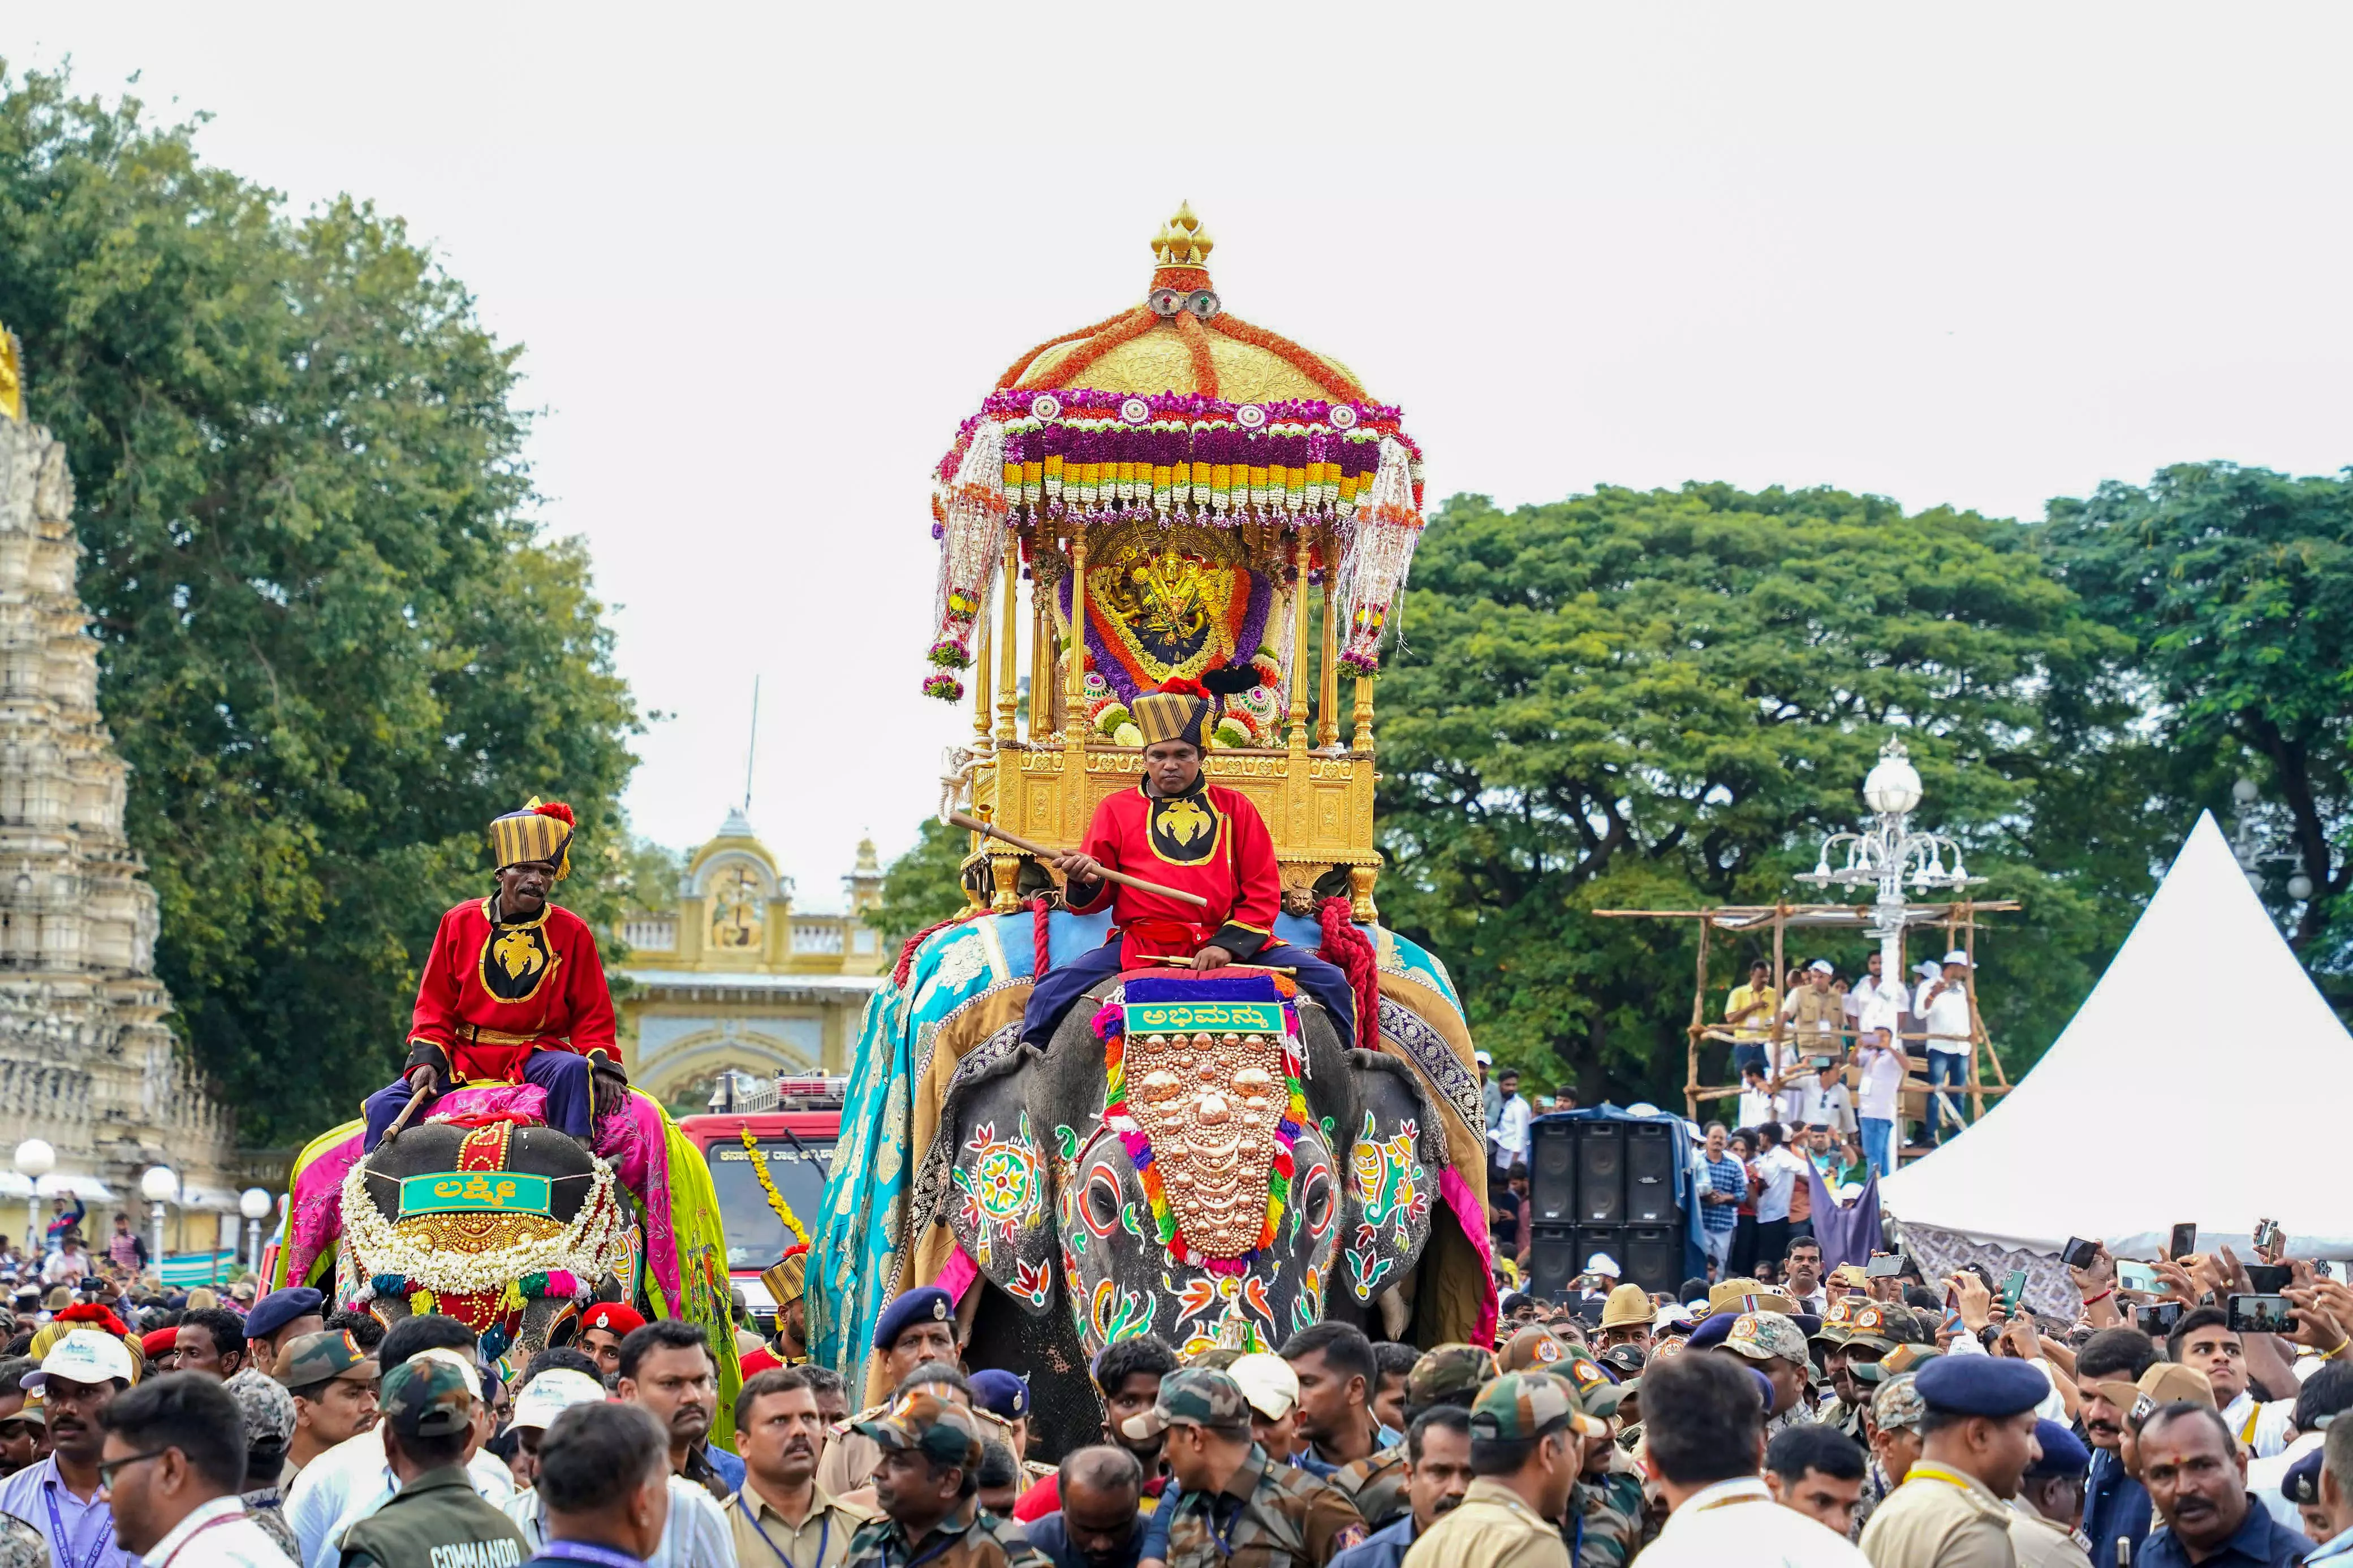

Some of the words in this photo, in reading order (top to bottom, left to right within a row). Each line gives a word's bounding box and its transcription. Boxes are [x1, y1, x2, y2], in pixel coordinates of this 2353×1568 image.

[1143, 1005, 1269, 1028] ಅಭಿಮನ್ಯು
[434, 1176, 516, 1206] ಲಕ್ಷ್ಮೀ
[98, 1519, 113, 1543] POLICE
[430, 1537, 521, 1568] COMMANDO
